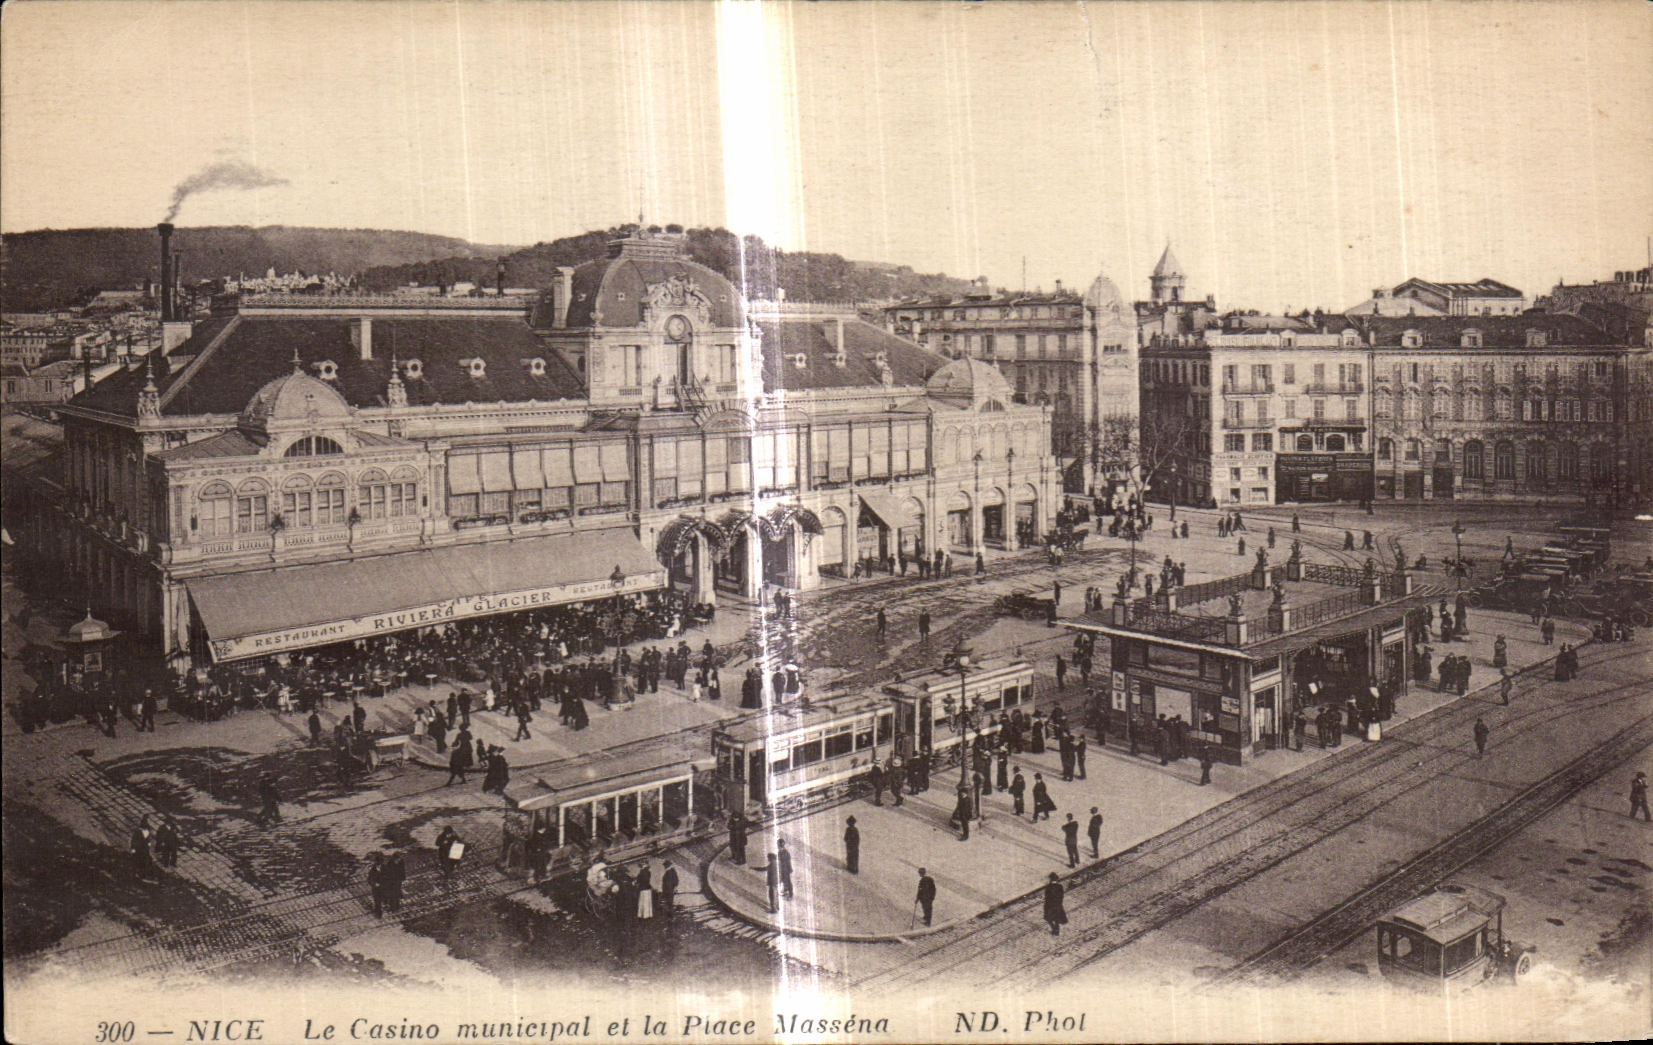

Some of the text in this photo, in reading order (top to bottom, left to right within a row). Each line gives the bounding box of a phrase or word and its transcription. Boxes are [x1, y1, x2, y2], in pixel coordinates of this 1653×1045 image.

[373, 591, 551, 627] RIVIERA GLACIER
[255, 624, 346, 647] RESTAURANT
